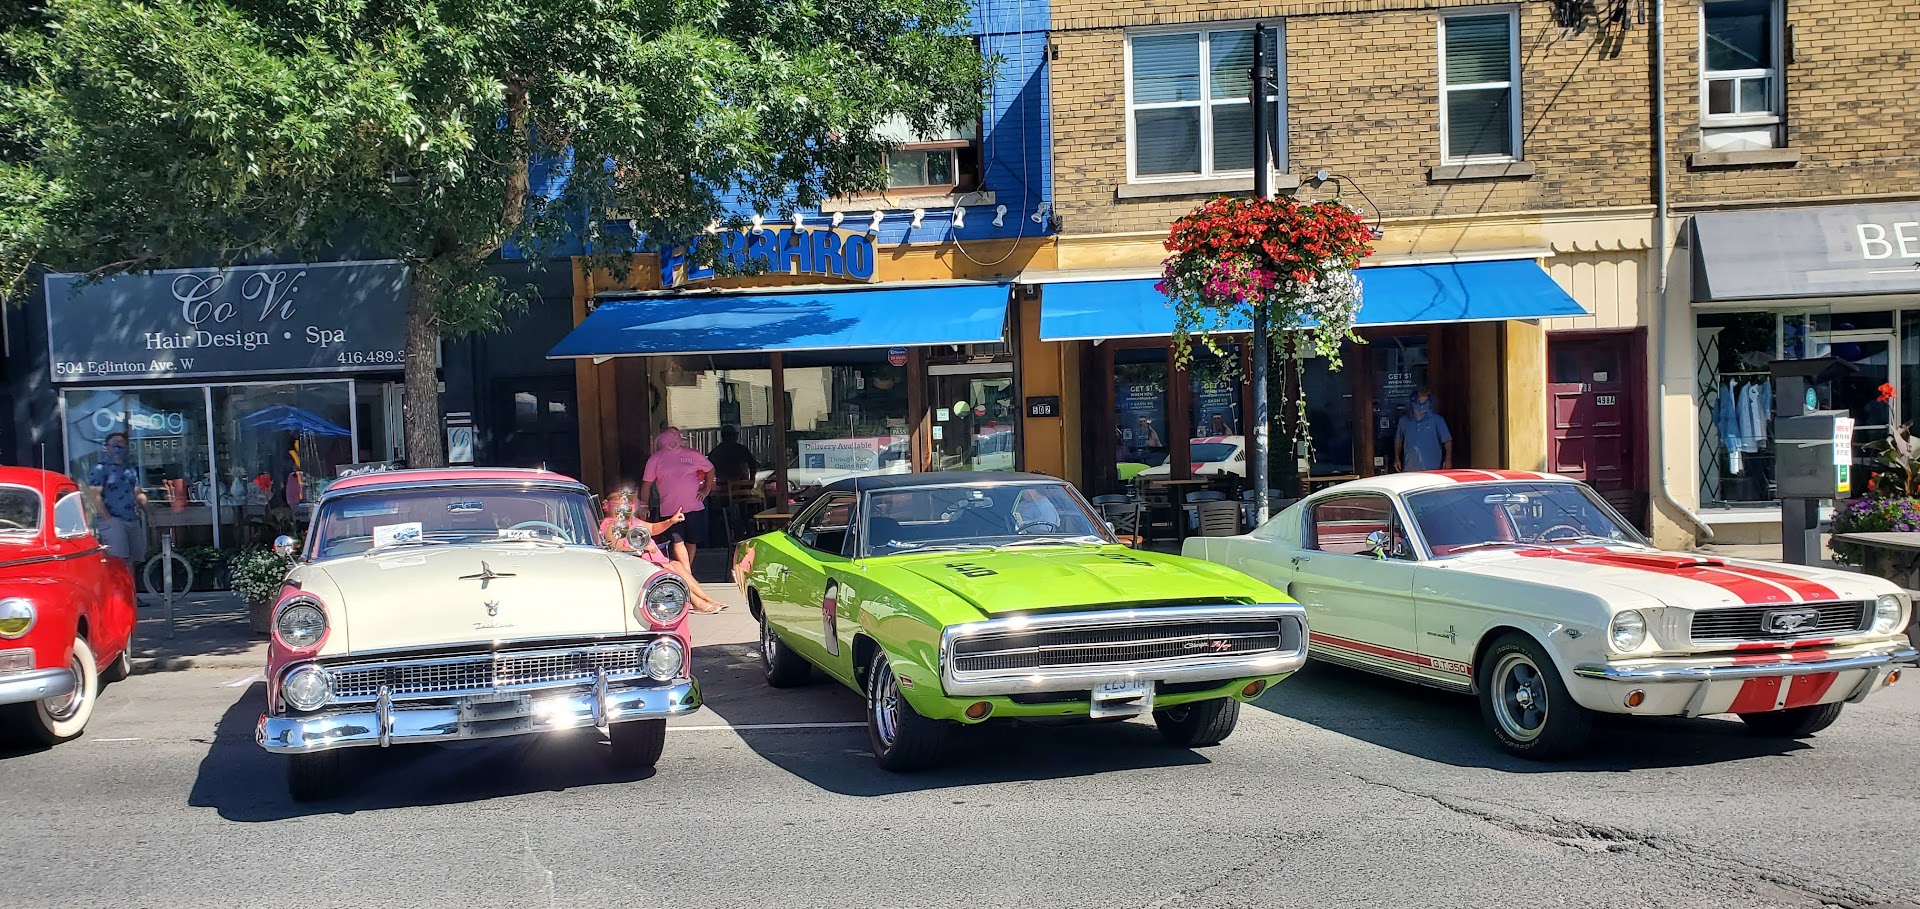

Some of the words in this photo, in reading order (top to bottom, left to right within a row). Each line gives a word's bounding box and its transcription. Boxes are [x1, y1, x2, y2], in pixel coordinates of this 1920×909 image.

[1856, 221, 1920, 259] BE
[171, 274, 237, 329] Co
[242, 271, 306, 321] Vi
[144, 332, 191, 350] Hair
[196, 330, 270, 350] Design
[306, 326, 346, 347] Spa
[56, 362, 84, 374] 504
[88, 360, 145, 376] Eglinton
[149, 359, 177, 371] Ave.
[180, 358, 194, 370] W
[1032, 405, 1050, 415] 502
[144, 440, 178, 449] HERE
[805, 443, 836, 451] Delivery
